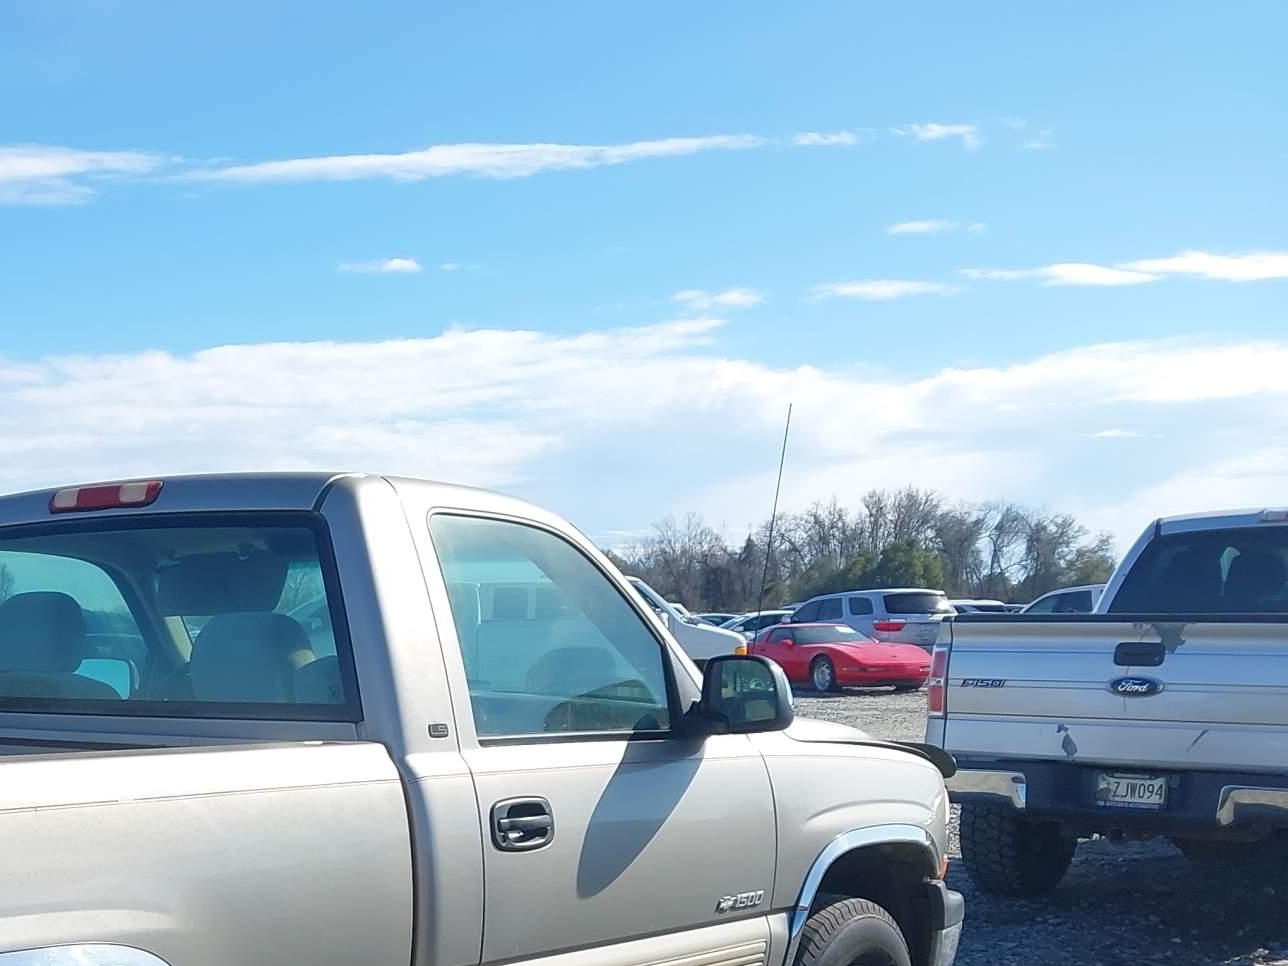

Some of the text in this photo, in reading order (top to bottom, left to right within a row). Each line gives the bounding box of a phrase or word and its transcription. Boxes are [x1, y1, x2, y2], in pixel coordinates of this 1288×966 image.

[1118, 679, 1149, 692] Ford
[1112, 781, 1163, 800] ZJW094
[735, 890, 765, 908] 1500
